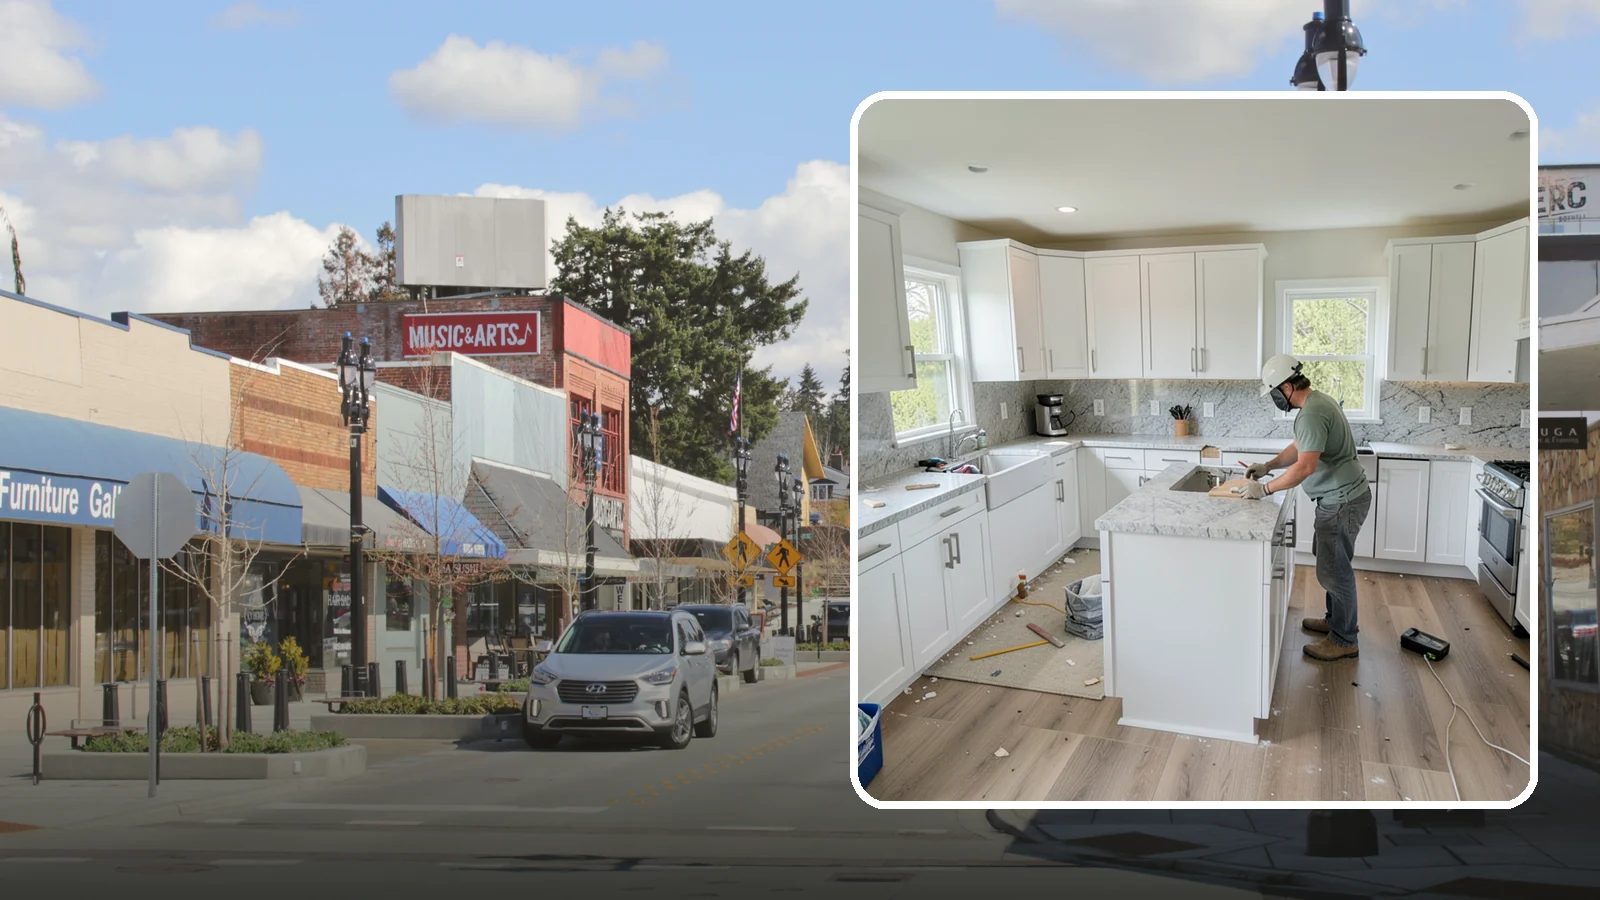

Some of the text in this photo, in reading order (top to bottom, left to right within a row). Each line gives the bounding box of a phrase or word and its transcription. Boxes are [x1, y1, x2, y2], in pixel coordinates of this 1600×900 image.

[409, 323, 519, 348] MUSIC&ARTS
[1540, 428, 1577, 436] UGA
[0, 471, 79, 515] Furniture
[453, 563, 479, 574] SUSHI
